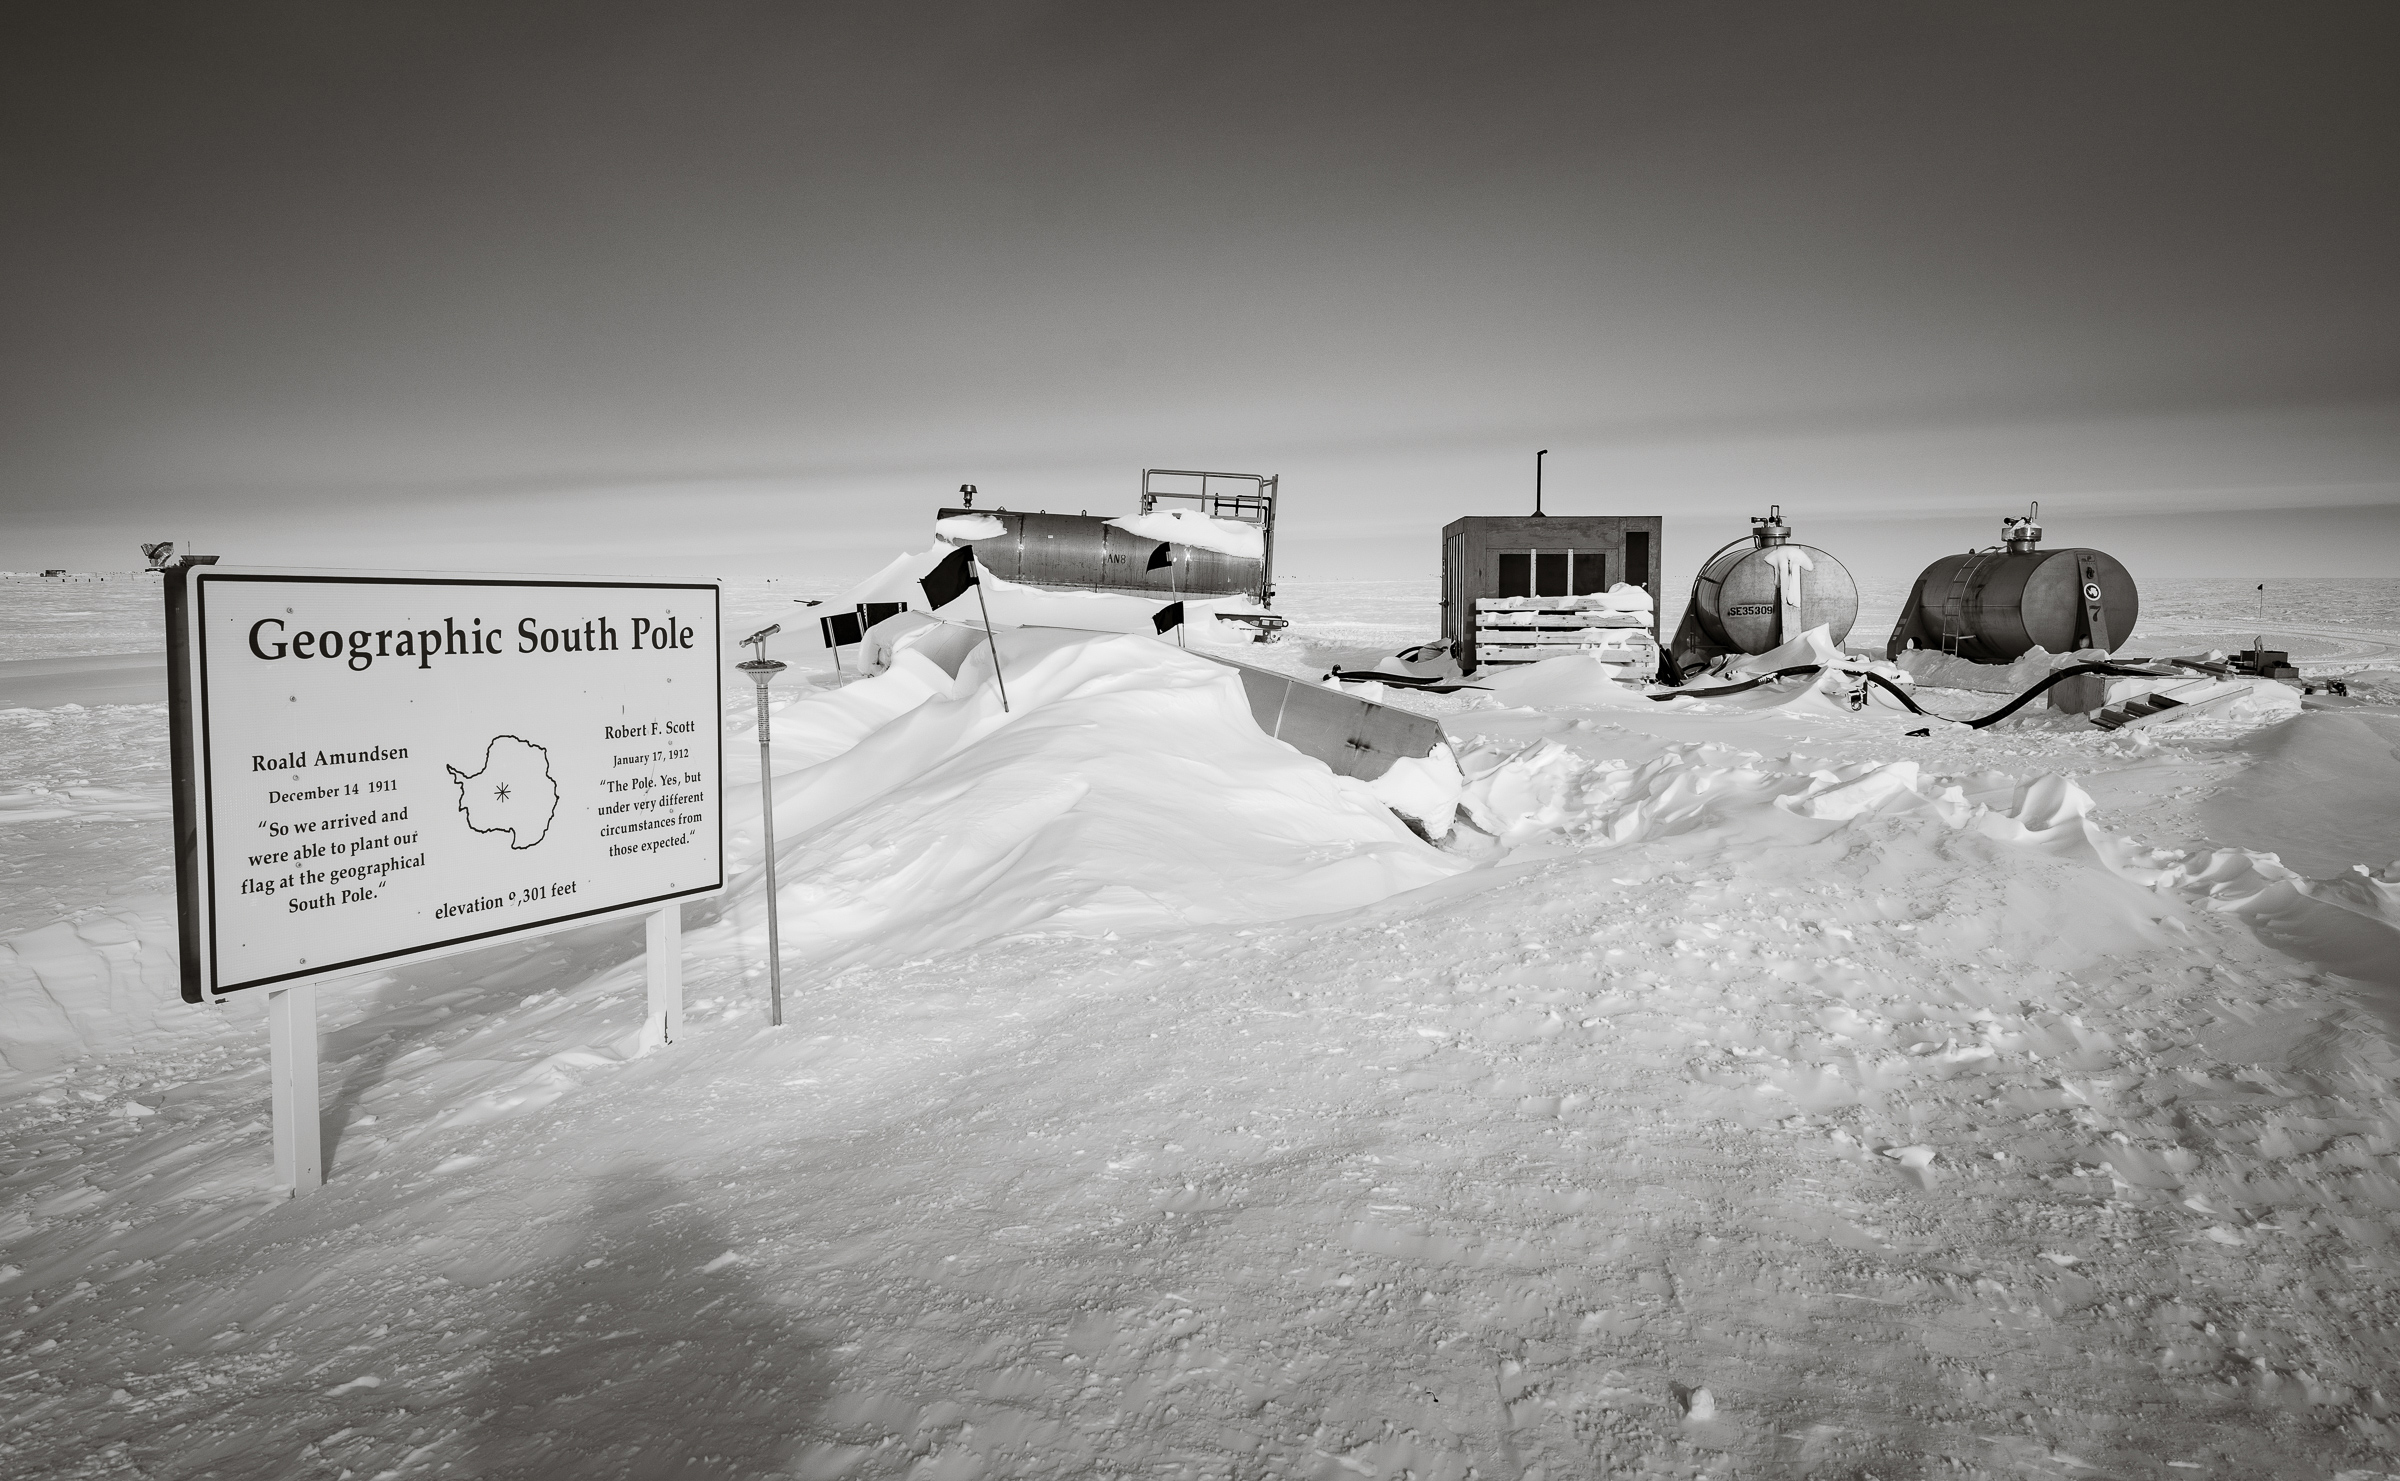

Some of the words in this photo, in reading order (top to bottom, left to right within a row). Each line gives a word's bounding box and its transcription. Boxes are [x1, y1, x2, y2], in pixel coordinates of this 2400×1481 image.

[1729, 605, 1773, 616] SE35309
[2088, 605, 2101, 622] 7
[248, 615, 503, 672] Geographic
[517, 615, 619, 654] South
[630, 615, 694, 650] Pole
[604, 724, 647, 740] Robert
[650, 722, 663, 736] F.
[665, 720, 695, 735] Scott
[251, 750, 307, 773] Roald
[313, 745, 409, 767] Amundsen
[612, 754, 649, 769] January
[652, 750, 667, 763] 17,
[668, 748, 689, 760] 1912
[268, 785, 340, 804] December
[343, 783, 360, 796] 14
[368, 779, 398, 794] 1911
[631, 776, 657, 790] Pole.
[659, 774, 681, 787] Yes,
[684, 771, 702, 784] but
[597, 801, 631, 816] under
[633, 799, 657, 813] very
[658, 791, 704, 808] different
[293, 821, 317, 834] we
[321, 809, 377, 831] arrived
[381, 805, 409, 823] and
[600, 817, 676, 838] circumstances
[678, 812, 703, 825] from
[247, 851, 289, 867] were
[293, 842, 326, 860] able
[330, 841, 346, 855] to
[350, 834, 390, 857] plant
[393, 833, 419, 846] our
[608, 844, 639, 857] those
[240, 878, 276, 896] flag
[279, 873, 295, 889] at
[299, 869, 326, 886] the
[329, 852, 426, 885] geographical
[288, 892, 336, 914] South
[435, 896, 504, 920] elevation
[551, 880, 577, 898] feet
